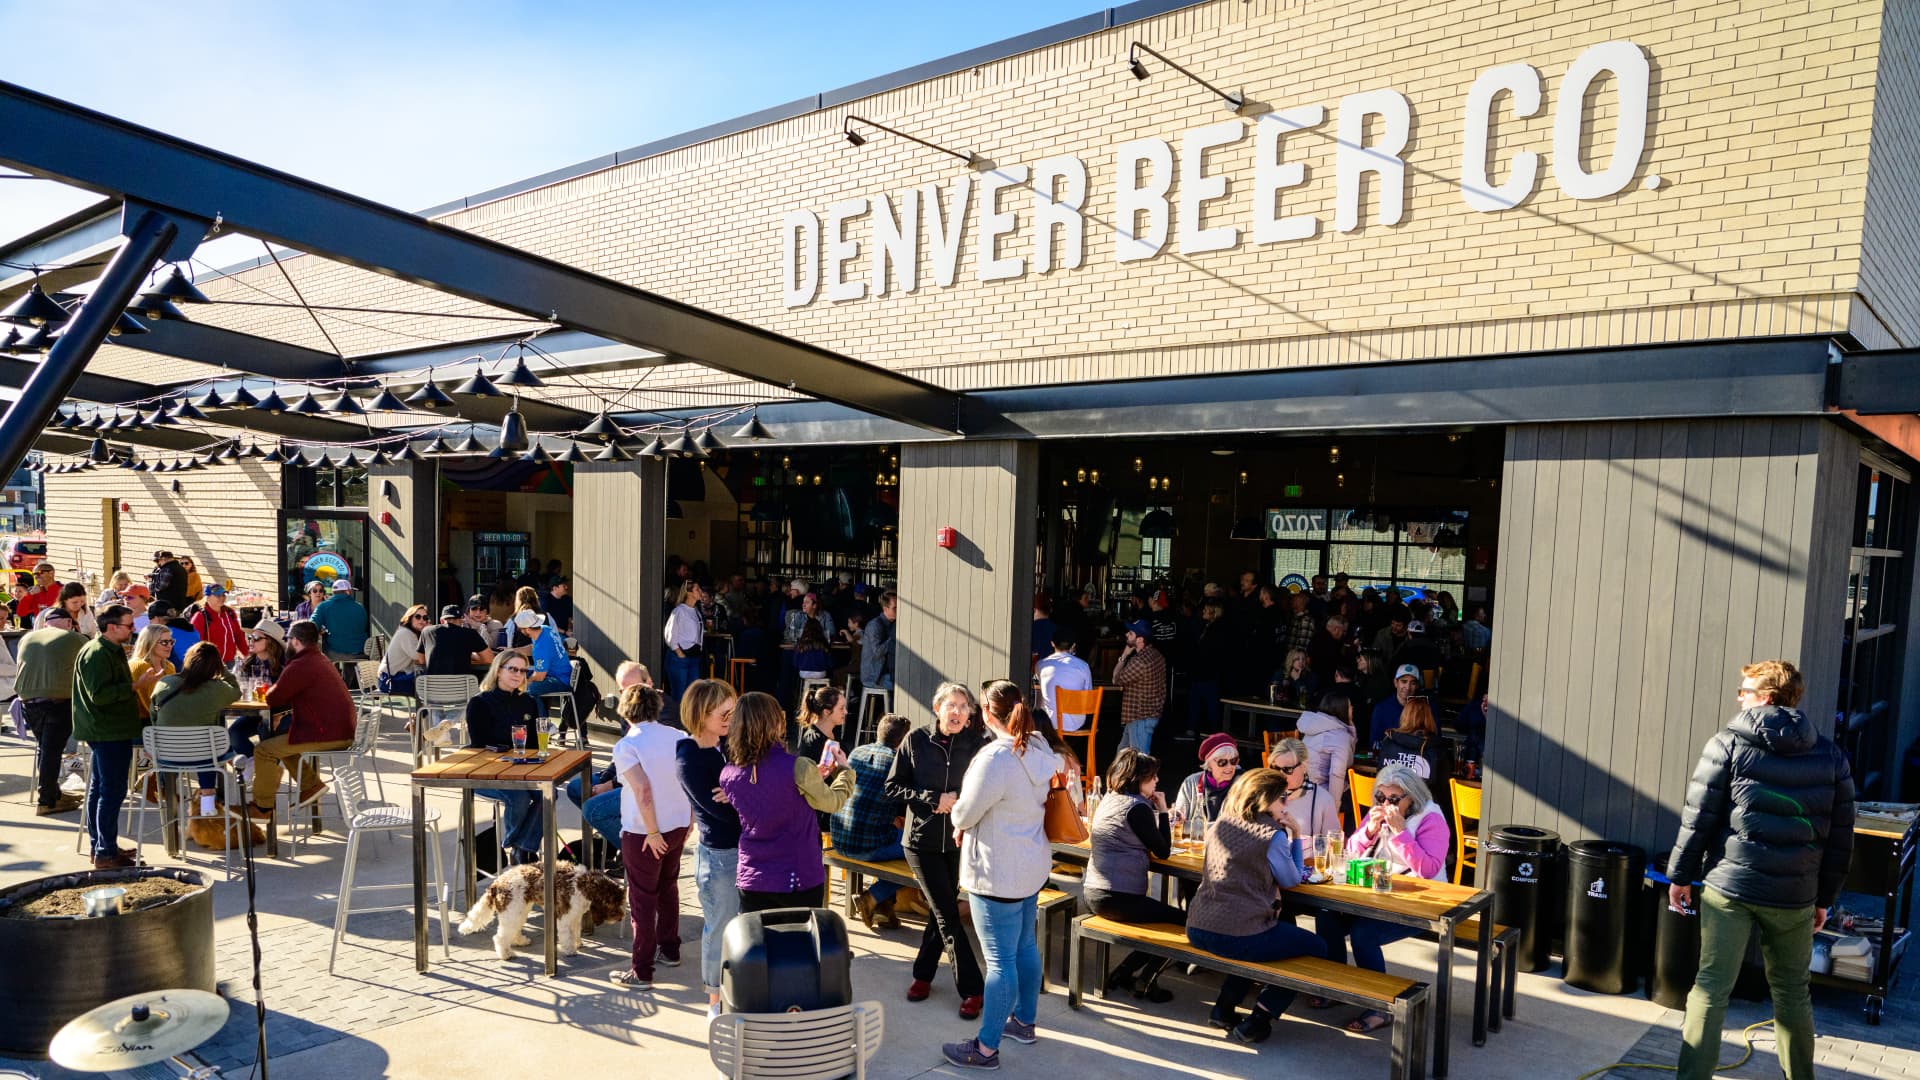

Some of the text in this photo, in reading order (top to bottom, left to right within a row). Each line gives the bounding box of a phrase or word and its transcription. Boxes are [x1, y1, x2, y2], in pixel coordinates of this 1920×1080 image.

[781, 40, 1662, 309] DENVER BEER CO.
[1398, 752, 1416, 761] THE
[1586, 890, 1607, 899] TRASH
